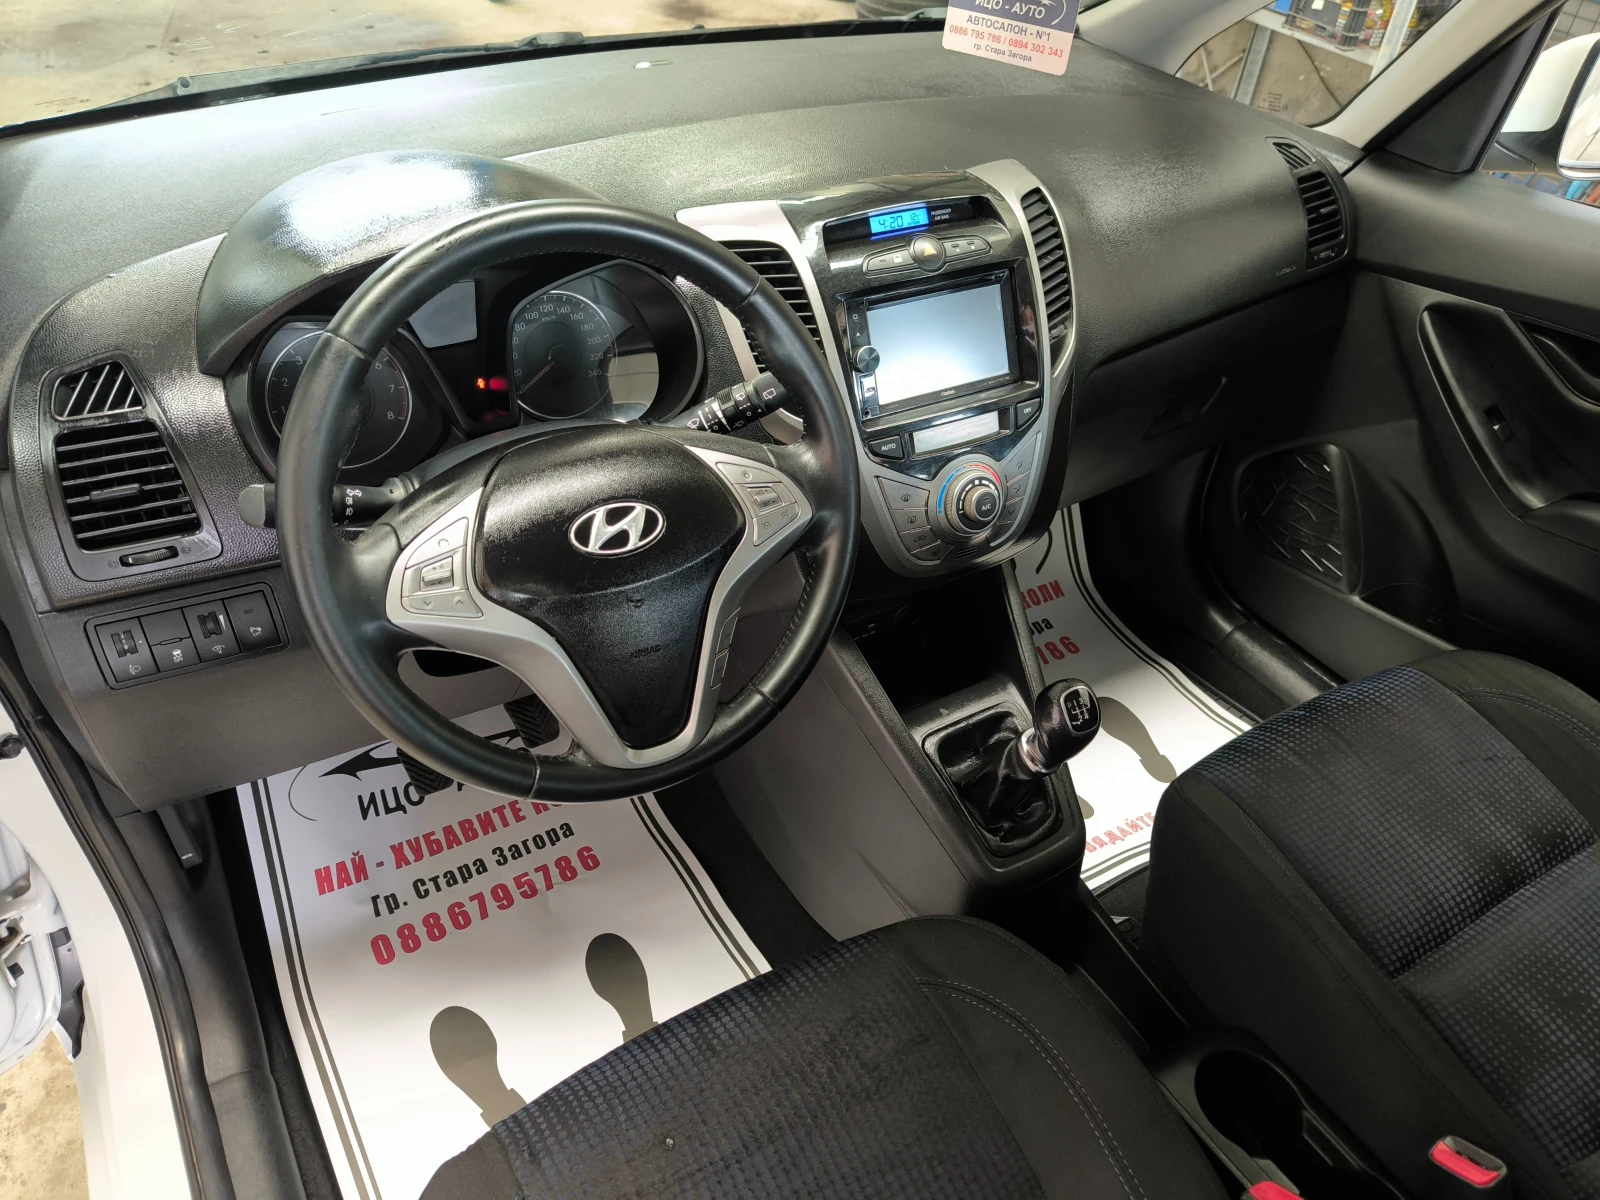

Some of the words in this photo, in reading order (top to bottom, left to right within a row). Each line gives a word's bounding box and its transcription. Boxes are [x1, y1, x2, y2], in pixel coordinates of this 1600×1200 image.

[1011, 2, 1045, 19] АУТО
[966, 14, 1028, 36] АВТОСАЛОН
[949, 24, 968, 36] 0886
[971, 30, 985, 40] 795
[987, 33, 1002, 44] 786
[1008, 37, 1028, 50] 0894
[1031, 42, 1046, 54] 302
[1048, 47, 1064, 58] 343
[985, 45, 1006, 56] Стара
[1007, 49, 1032, 62] Загора
[878, 215, 904, 230] 4:20
[540, 304, 554, 312] 120
[556, 306, 571, 314] 140
[525, 312, 539, 320] 100
[515, 322, 526, 331] 80
[580, 323, 594, 331] 180
[587, 337, 601, 345] 200
[296, 356, 303, 365] 3
[590, 353, 604, 361] 220
[375, 361, 382, 369] 6
[588, 369, 602, 377] 240
[282, 378, 289, 387] 2
[388, 385, 395, 393] 7
[387, 411, 395, 420] 8
[881, 443, 896, 451] AUTO
[982, 503, 991, 511] A/C
[357, 782, 425, 821] ИЦО
[314, 851, 369, 896] НАЙ
[389, 800, 527, 870] ХУБАВИТЕ
[370, 895, 408, 918] Гр.
[412, 859, 489, 900] Стара
[492, 821, 575, 867] Загора
[370, 845, 601, 966] 0886795786
